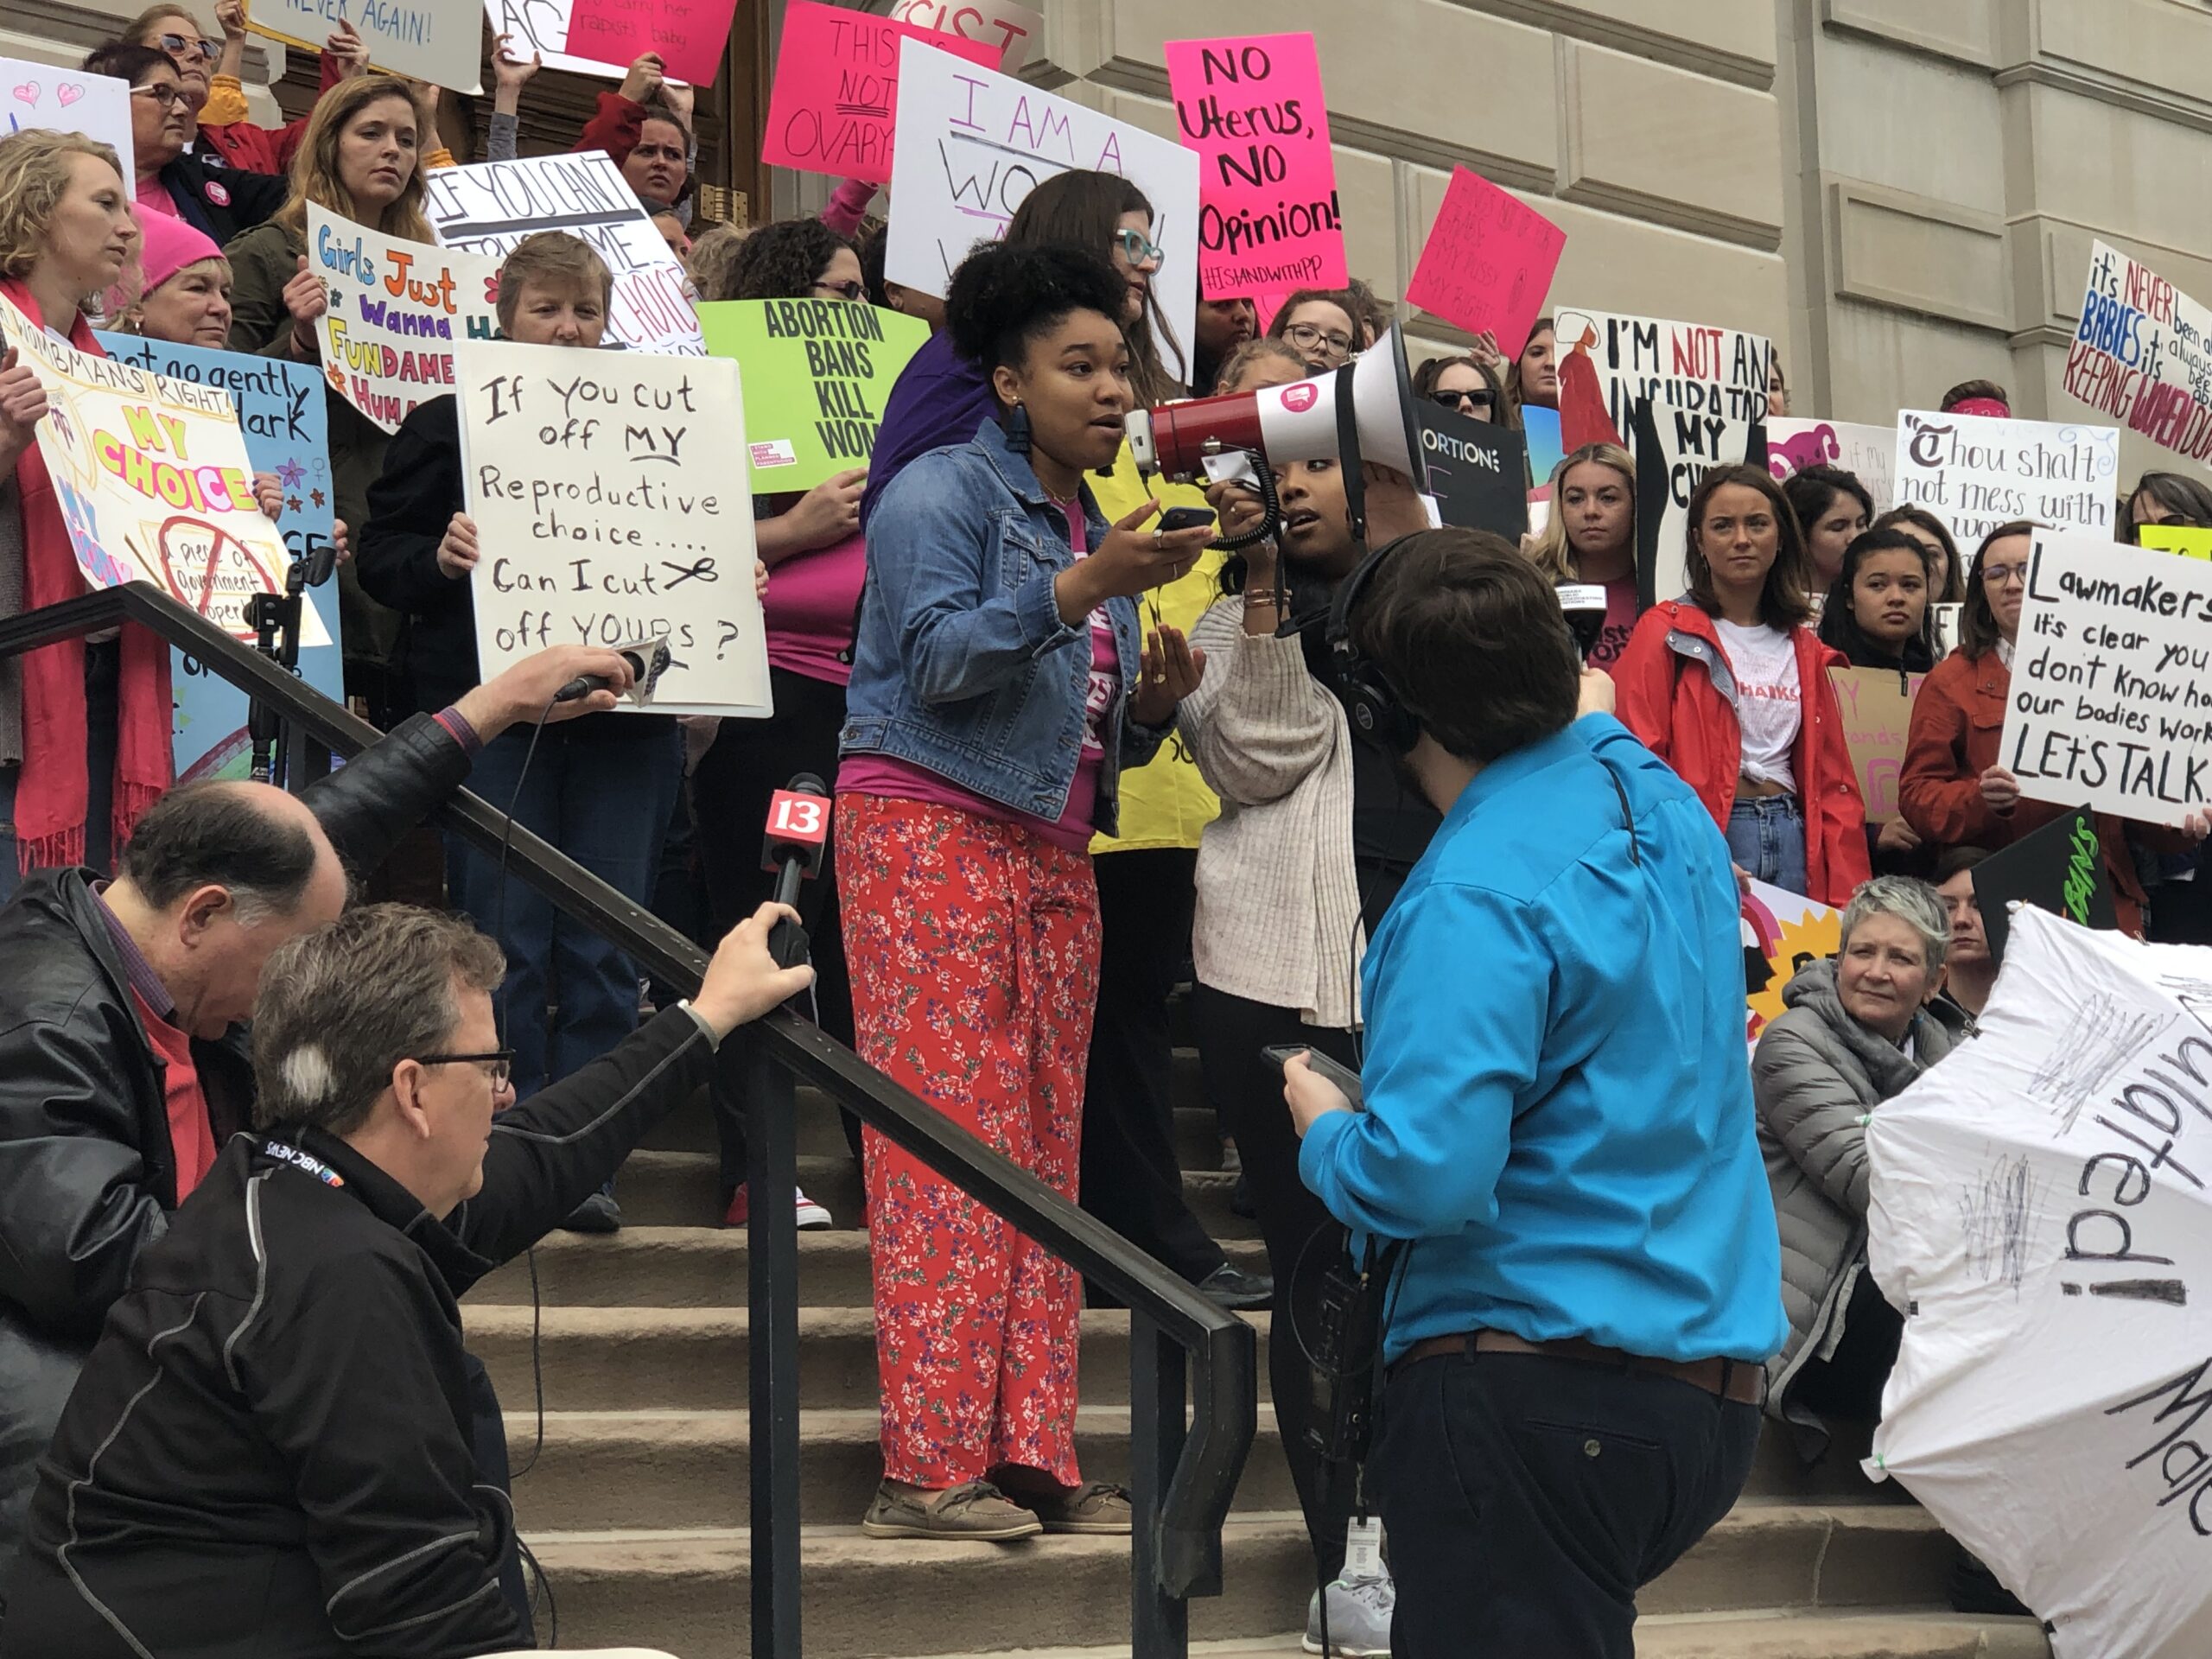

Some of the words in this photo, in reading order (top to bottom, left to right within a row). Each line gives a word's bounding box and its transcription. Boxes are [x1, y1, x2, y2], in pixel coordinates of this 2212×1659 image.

[359, 0, 431, 45] AGAIN!
[651, 22, 688, 53] baby
[829, 20, 895, 68] THIS
[837, 71, 897, 107] NOT
[1201, 46, 1272, 86] NO
[950, 73, 989, 132] I
[1007, 95, 1075, 162] AM
[1096, 131, 1123, 176] A
[425, 171, 469, 223] IF
[463, 162, 557, 219] YOU
[538, 155, 632, 216] CAN'T
[1217, 144, 1287, 188] NO
[1199, 189, 1343, 256] Opinion!
[318, 224, 376, 286] Girls
[384, 248, 458, 315] Just
[359, 294, 453, 340] Wanna
[763, 299, 886, 343] ABORTION
[2091, 252, 2119, 299] it's
[2123, 258, 2174, 327] NEVER
[2173, 291, 2201, 348] been
[2078, 289, 2146, 368] BABIES
[804, 340, 874, 379] BANS
[1606, 317, 1660, 374] I'M
[1671, 324, 1725, 382] NOT
[1732, 334, 1770, 393] AN
[153, 372, 230, 416] RIGHT!
[480, 375, 524, 426] If
[814, 379, 876, 420] KILL
[2063, 340, 2139, 420] KEEPING
[2128, 372, 2196, 453] WOMEN
[122, 404, 189, 461] MY
[539, 418, 601, 450] off
[626, 423, 687, 458] MY
[1673, 410, 1727, 461] MY
[93, 428, 259, 513] CHOICE
[2018, 442, 2097, 483] shalt
[479, 464, 720, 516] Reproductive
[1901, 469, 1949, 505] not
[1958, 481, 2025, 518] mess
[2040, 492, 2107, 526] with
[180, 543, 224, 568] piec
[493, 557, 557, 594] Can
[569, 558, 593, 593] I
[604, 562, 659, 596] cut
[2028, 541, 2212, 623] Lawmakers
[495, 610, 552, 652] off
[2033, 612, 2068, 639] It's
[2082, 624, 2150, 651] clear
[2154, 642, 2210, 674] you
[2028, 645, 2107, 690] don't
[2114, 664, 2180, 703] know
[2183, 679, 2212, 709] ho
[2017, 690, 2065, 715] our
[2075, 695, 2150, 734] bodies
[774, 798, 822, 834] 13
[265, 1141, 297, 1160] NEWS
[291, 1152, 326, 1175] NBC
